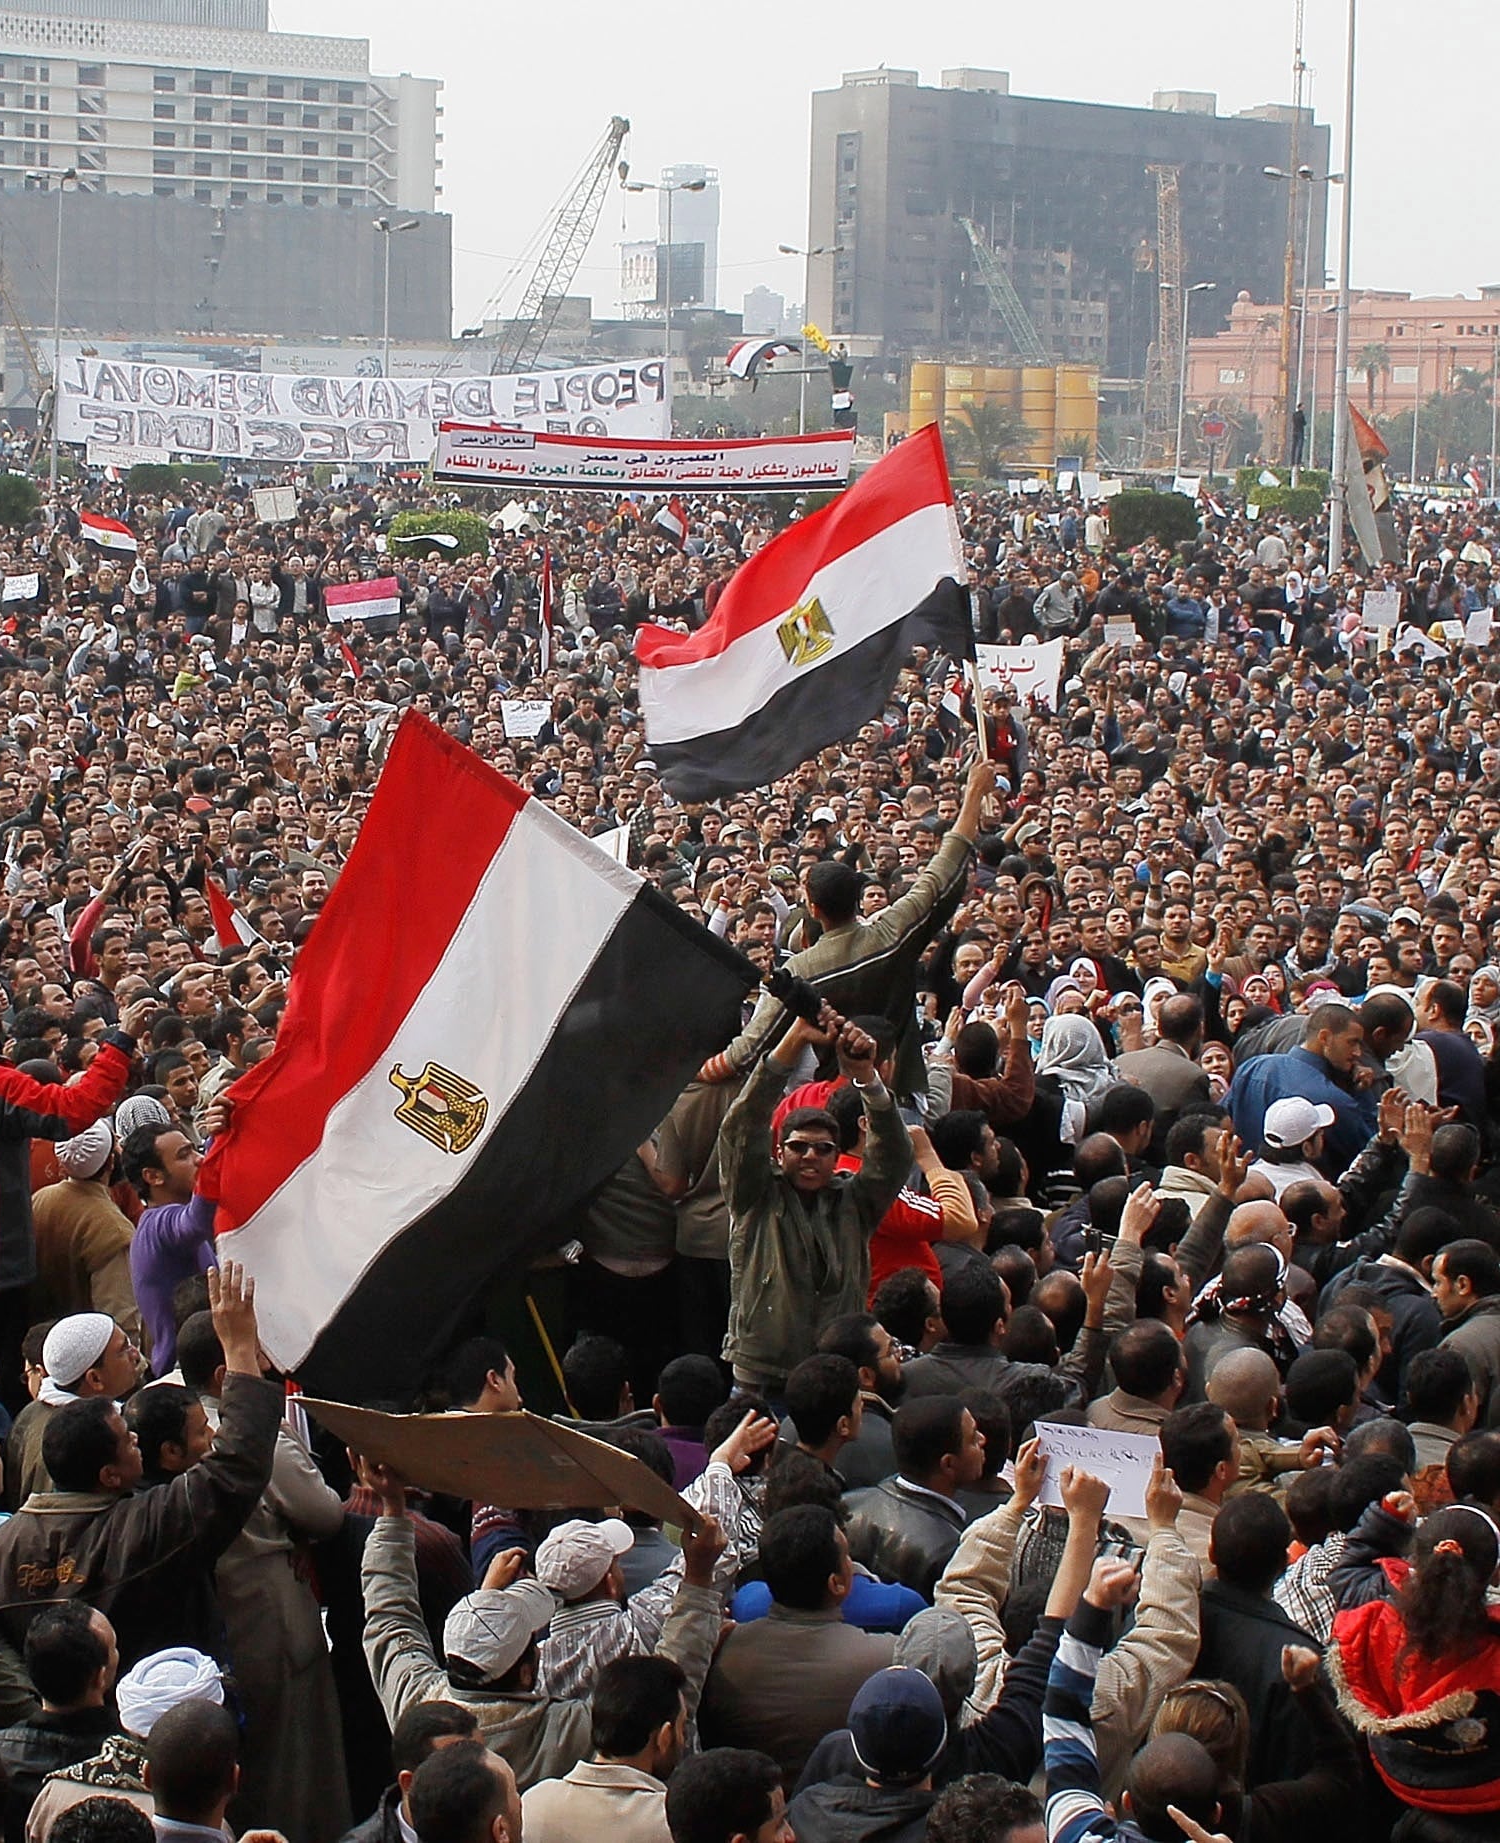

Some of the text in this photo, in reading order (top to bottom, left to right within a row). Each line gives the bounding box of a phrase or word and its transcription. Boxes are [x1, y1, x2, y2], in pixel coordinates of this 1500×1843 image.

[445, 454, 483, 469] النظام
[582, 454, 618, 463] مصر
[487, 458, 525, 474] وسقوط
[529, 460, 574, 476] المجرمين
[579, 465, 625, 479] ومحاكمة
[718, 464, 743, 478] لجنة
[748, 463, 787, 480] بتشكيل
[628, 467, 672, 480] الحقائق
[676, 467, 714, 480] لتقصى
[990, 655, 1035, 683] نريد
